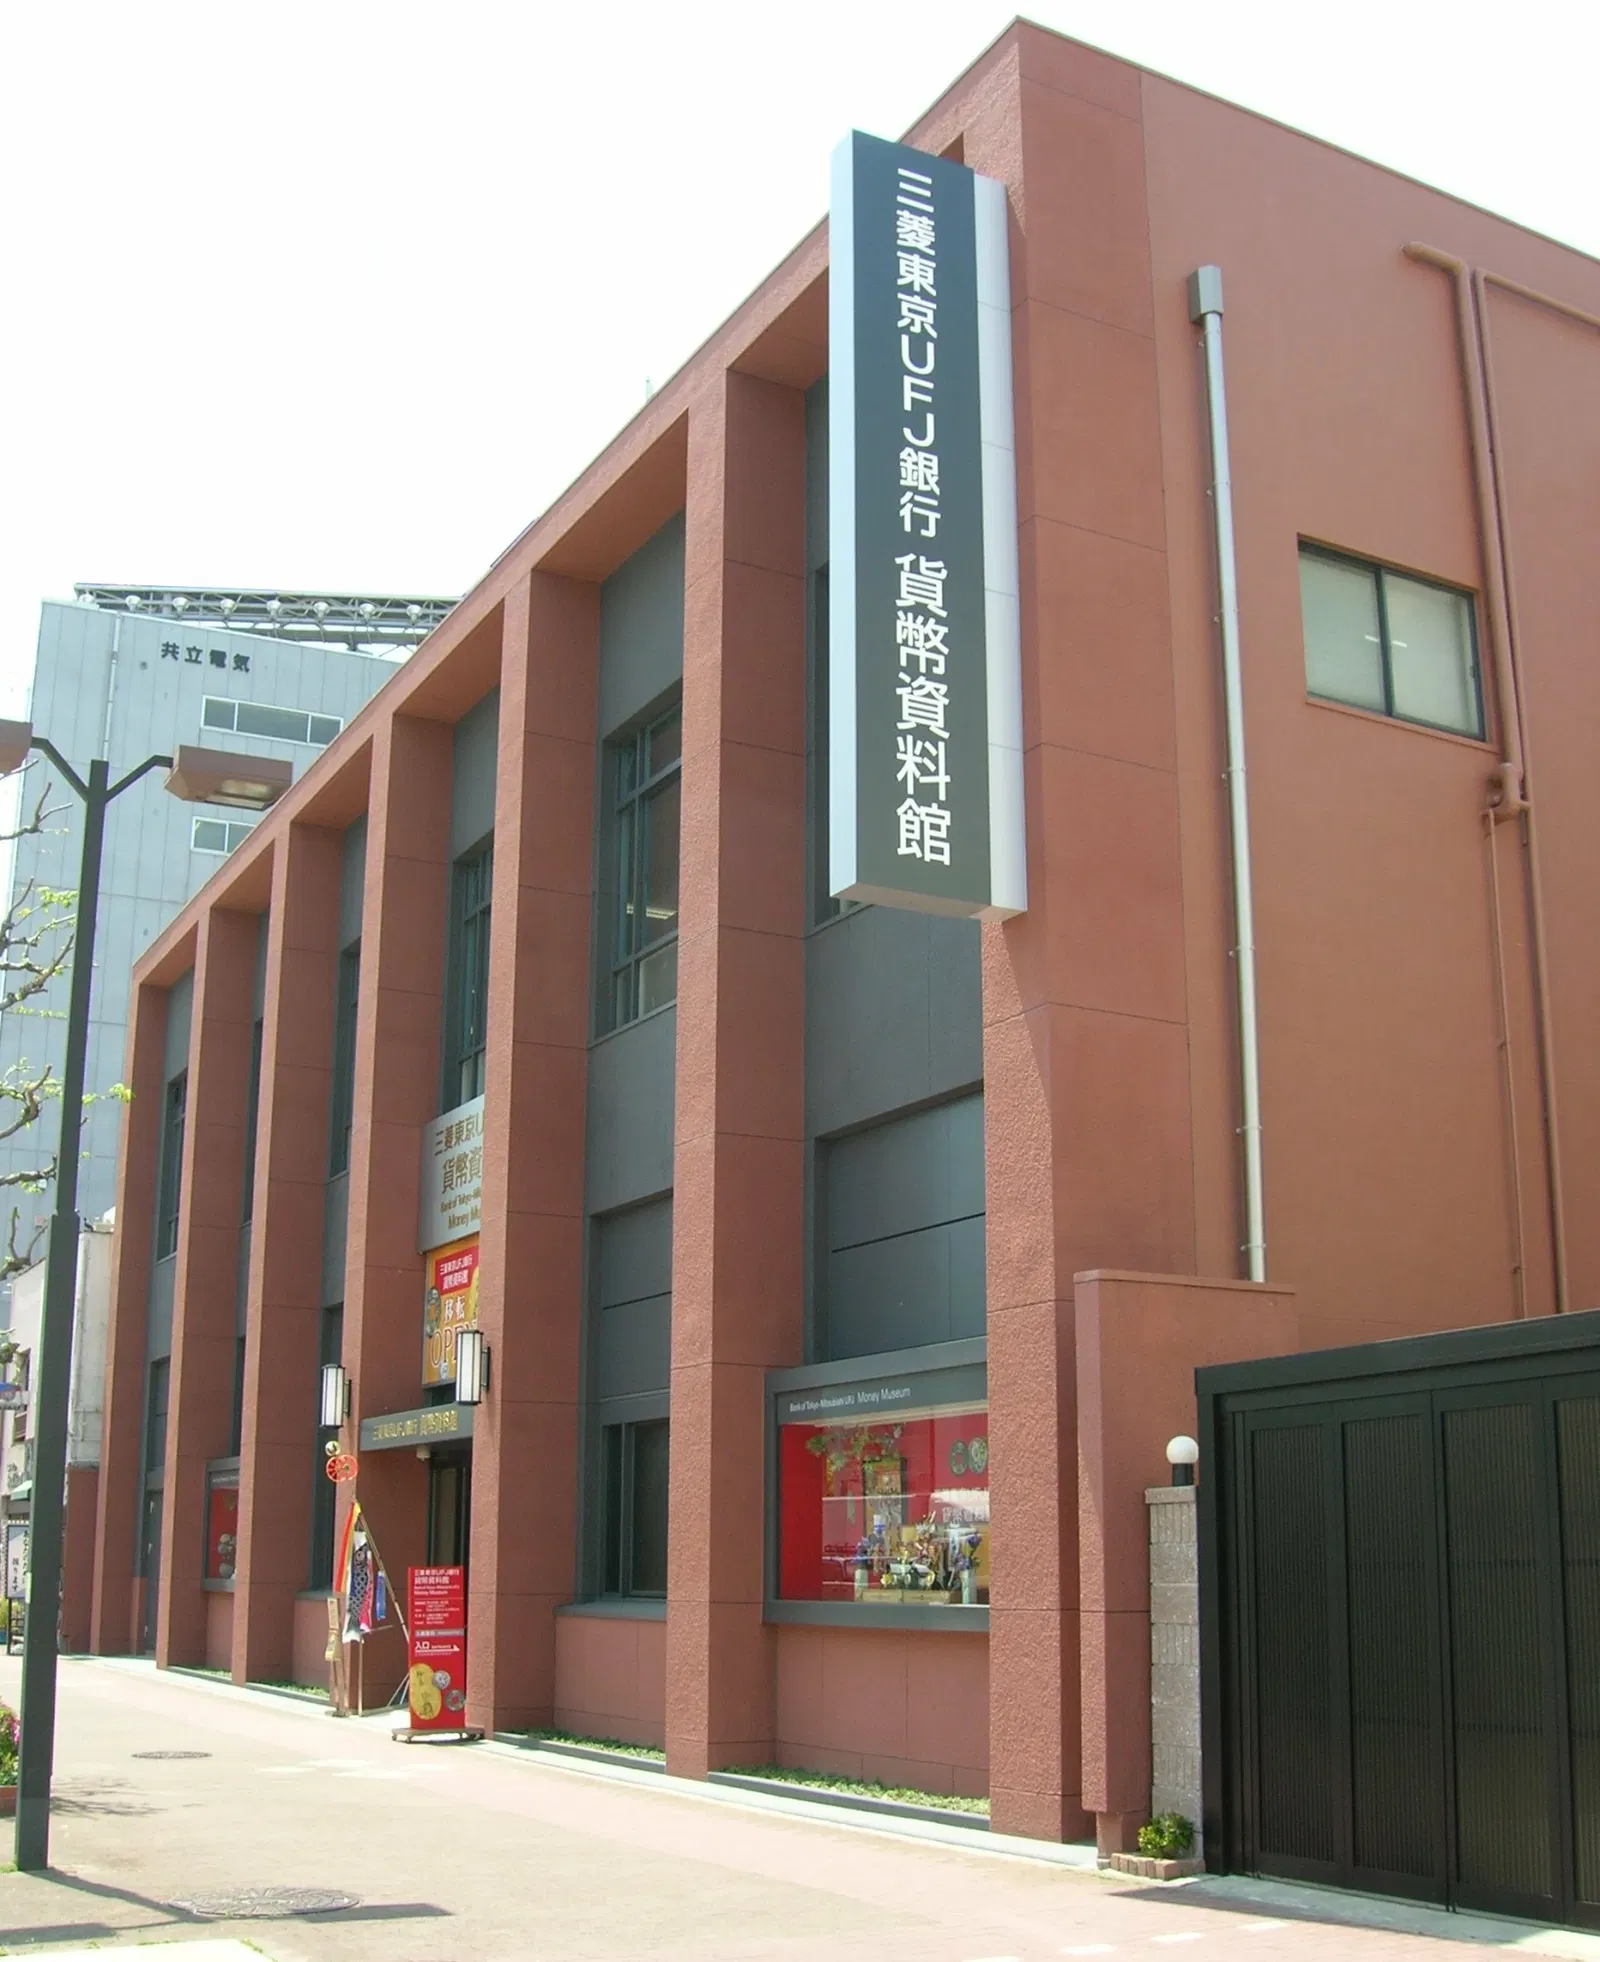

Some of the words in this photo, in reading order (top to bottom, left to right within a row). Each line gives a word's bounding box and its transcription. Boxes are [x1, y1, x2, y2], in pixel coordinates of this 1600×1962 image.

[896, 167, 941, 537] 三菱東京UFJ銀行
[895, 553, 951, 866] 貨幣資料館
[857, 1391, 879, 1404] Money
[880, 1387, 911, 1400] Museum
[415, 1641, 430, 1650] 入口
